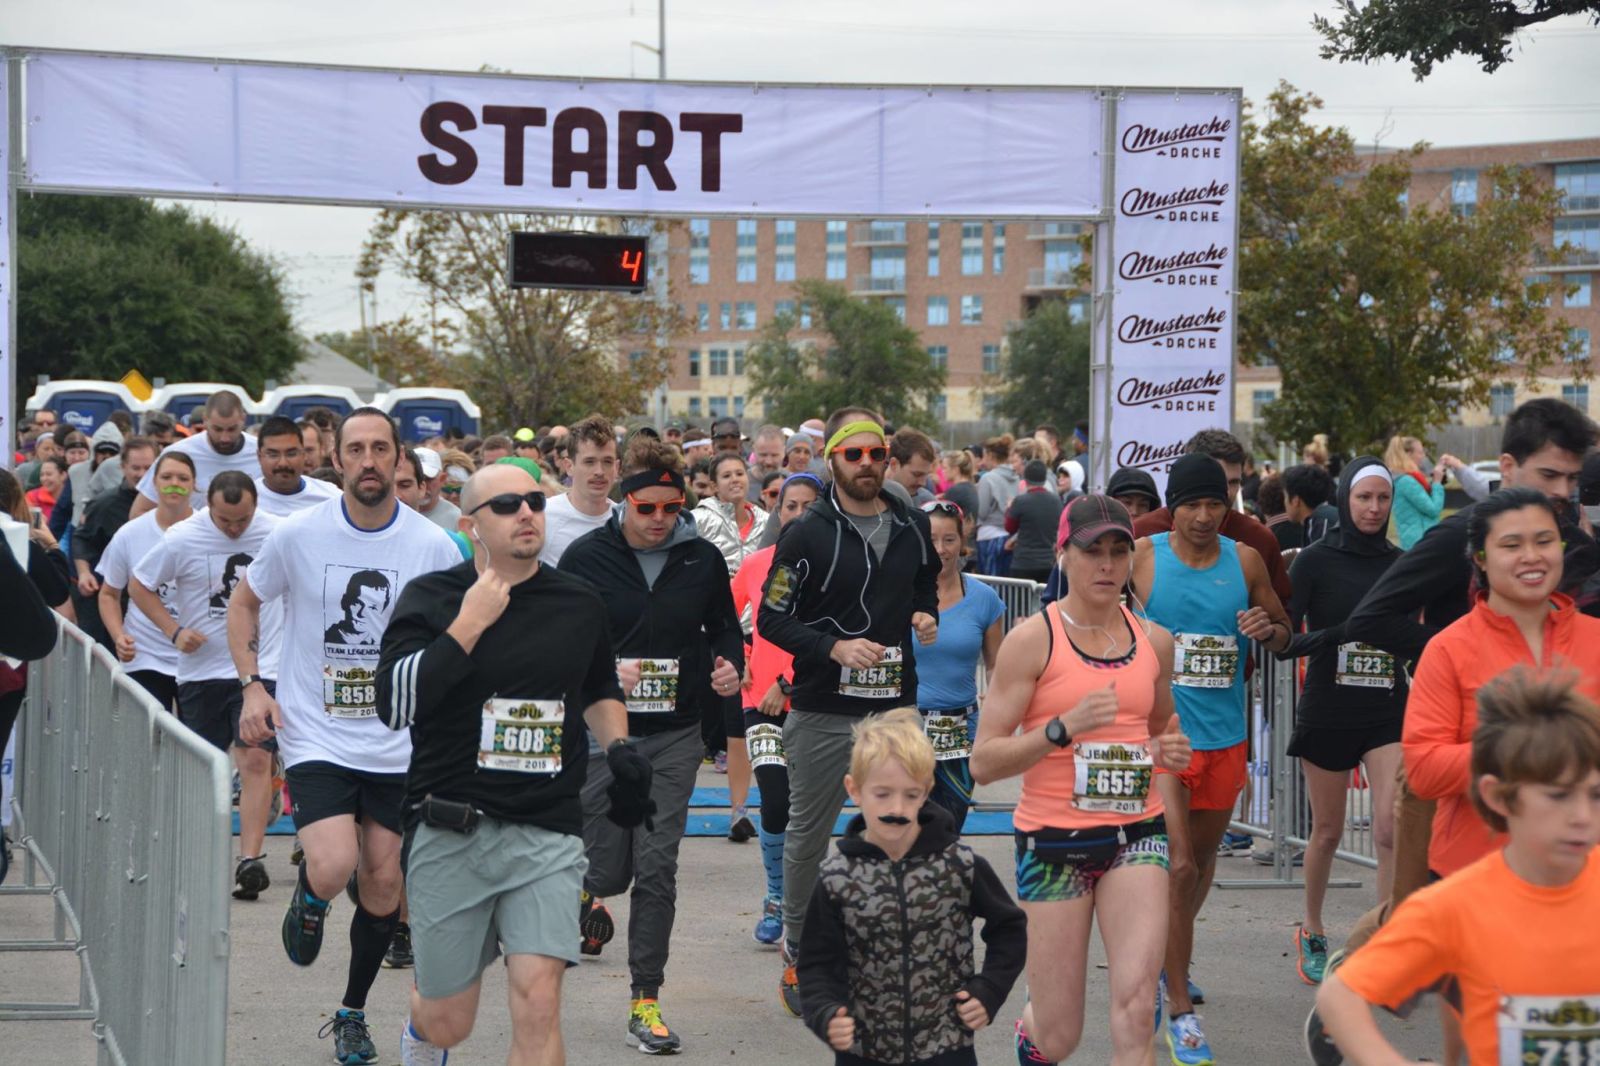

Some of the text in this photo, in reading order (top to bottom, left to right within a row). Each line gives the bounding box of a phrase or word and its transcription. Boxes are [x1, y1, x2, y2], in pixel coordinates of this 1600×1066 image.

[1122, 115, 1231, 154] Mustache
[418, 101, 743, 192] START
[1170, 147, 1221, 158] DACHE
[1120, 179, 1229, 217] Mustache
[1169, 211, 1219, 222] DACHE
[622, 250, 643, 282] 4
[1119, 243, 1228, 280] Mustache
[1167, 275, 1218, 285] DACHE
[1118, 306, 1226, 344] Mustache
[1166, 338, 1217, 348] DACHE
[1117, 369, 1225, 406] Mustache
[1165, 400, 1216, 411] DACHE
[1117, 440, 1185, 469] Must
[326, 646, 381, 656] TEAM LEGENDA
[642, 663, 668, 672] STIN
[1190, 655, 1221, 673] 631
[1353, 656, 1381, 673] 623
[857, 667, 887, 684] 854
[341, 685, 376, 704] 858
[631, 679, 662, 697] 853
[508, 706, 545, 719] PAUL
[647, 702, 664, 710] 2015
[928, 719, 954, 728] AUST
[503, 727, 545, 753] 608
[753, 739, 776, 755] 644
[525, 760, 546, 769] 2015
[1096, 769, 1135, 795] 655
[1527, 1007, 1600, 1024] AUSTI
